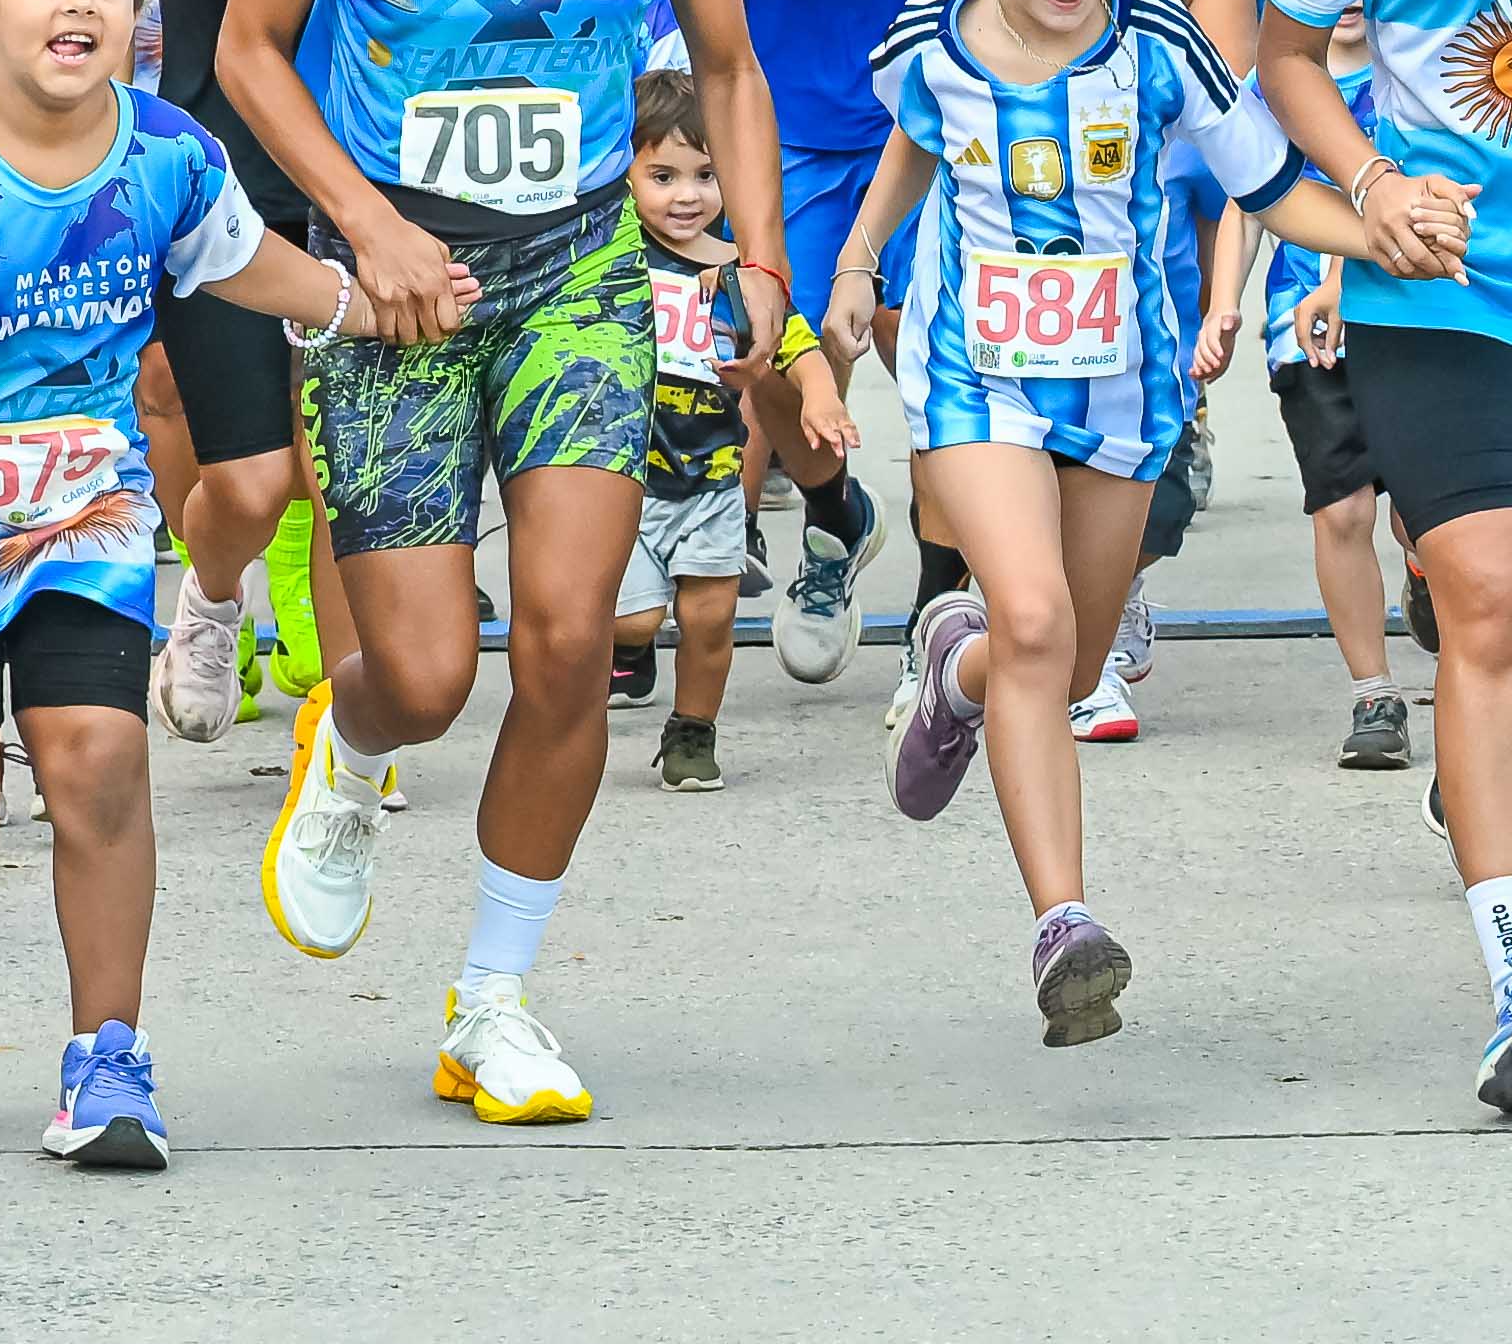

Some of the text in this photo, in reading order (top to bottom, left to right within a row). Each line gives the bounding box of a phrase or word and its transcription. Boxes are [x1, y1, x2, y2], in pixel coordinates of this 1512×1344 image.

[414, 103, 565, 185] 705
[1091, 142, 1121, 168] AFA
[516, 190, 564, 204] CARUSO
[16, 253, 151, 291] MARATÓN
[16, 273, 149, 309] HÉROES DE
[976, 263, 1122, 346] 584
[653, 281, 713, 353] 56
[1071, 353, 1118, 366] CARUSO
[61, 476, 105, 505] CARUSO
